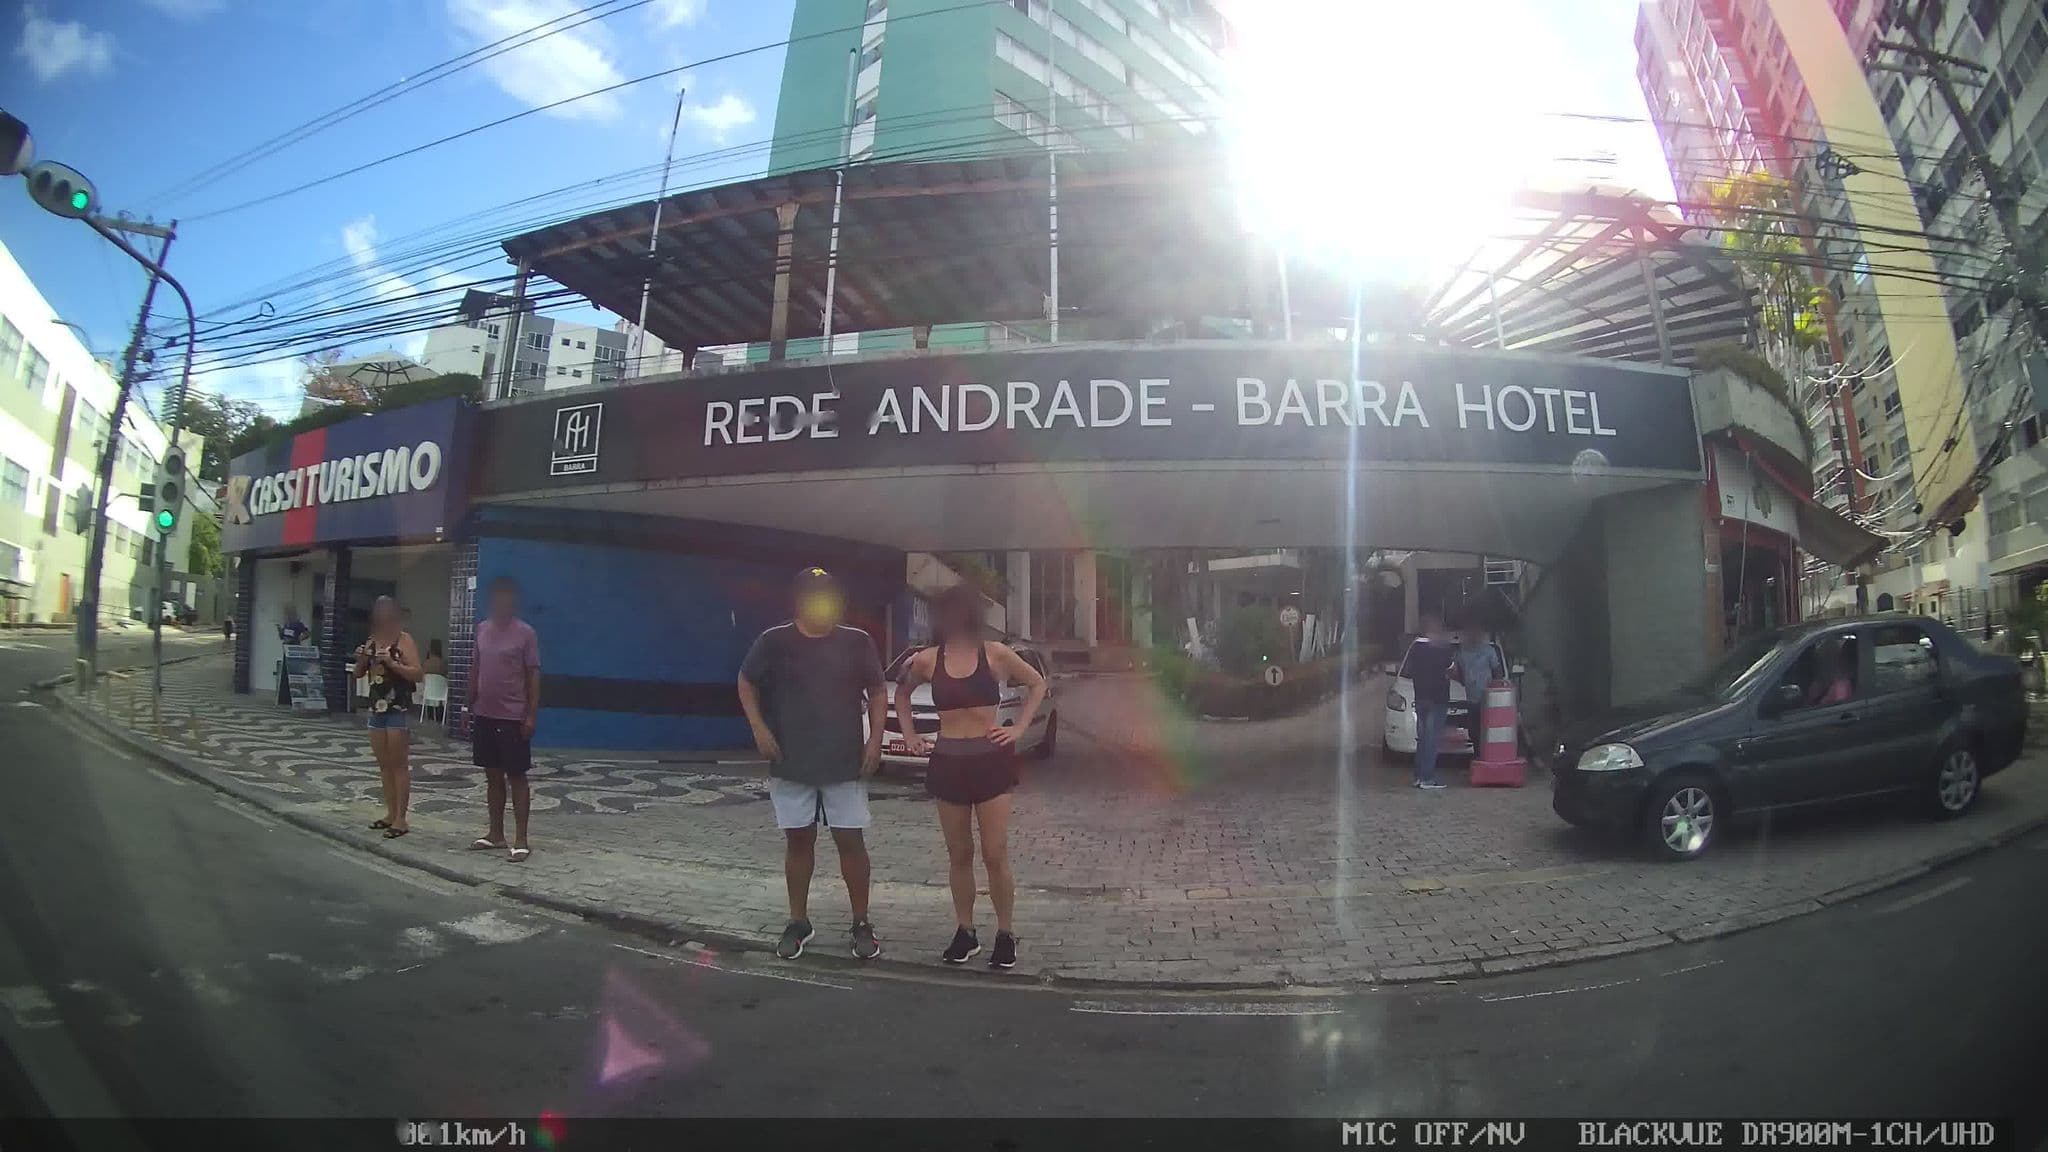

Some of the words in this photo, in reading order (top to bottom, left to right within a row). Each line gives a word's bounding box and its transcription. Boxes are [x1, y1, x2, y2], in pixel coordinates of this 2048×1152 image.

[704, 392, 840, 446] REDE
[869, 376, 1173, 436] ANDRADE
[1191, 403, 1215, 411] -
[1236, 376, 1430, 429] BARRA
[1456, 383, 1617, 436] HOTEL
[563, 462, 586, 472] BARRA
